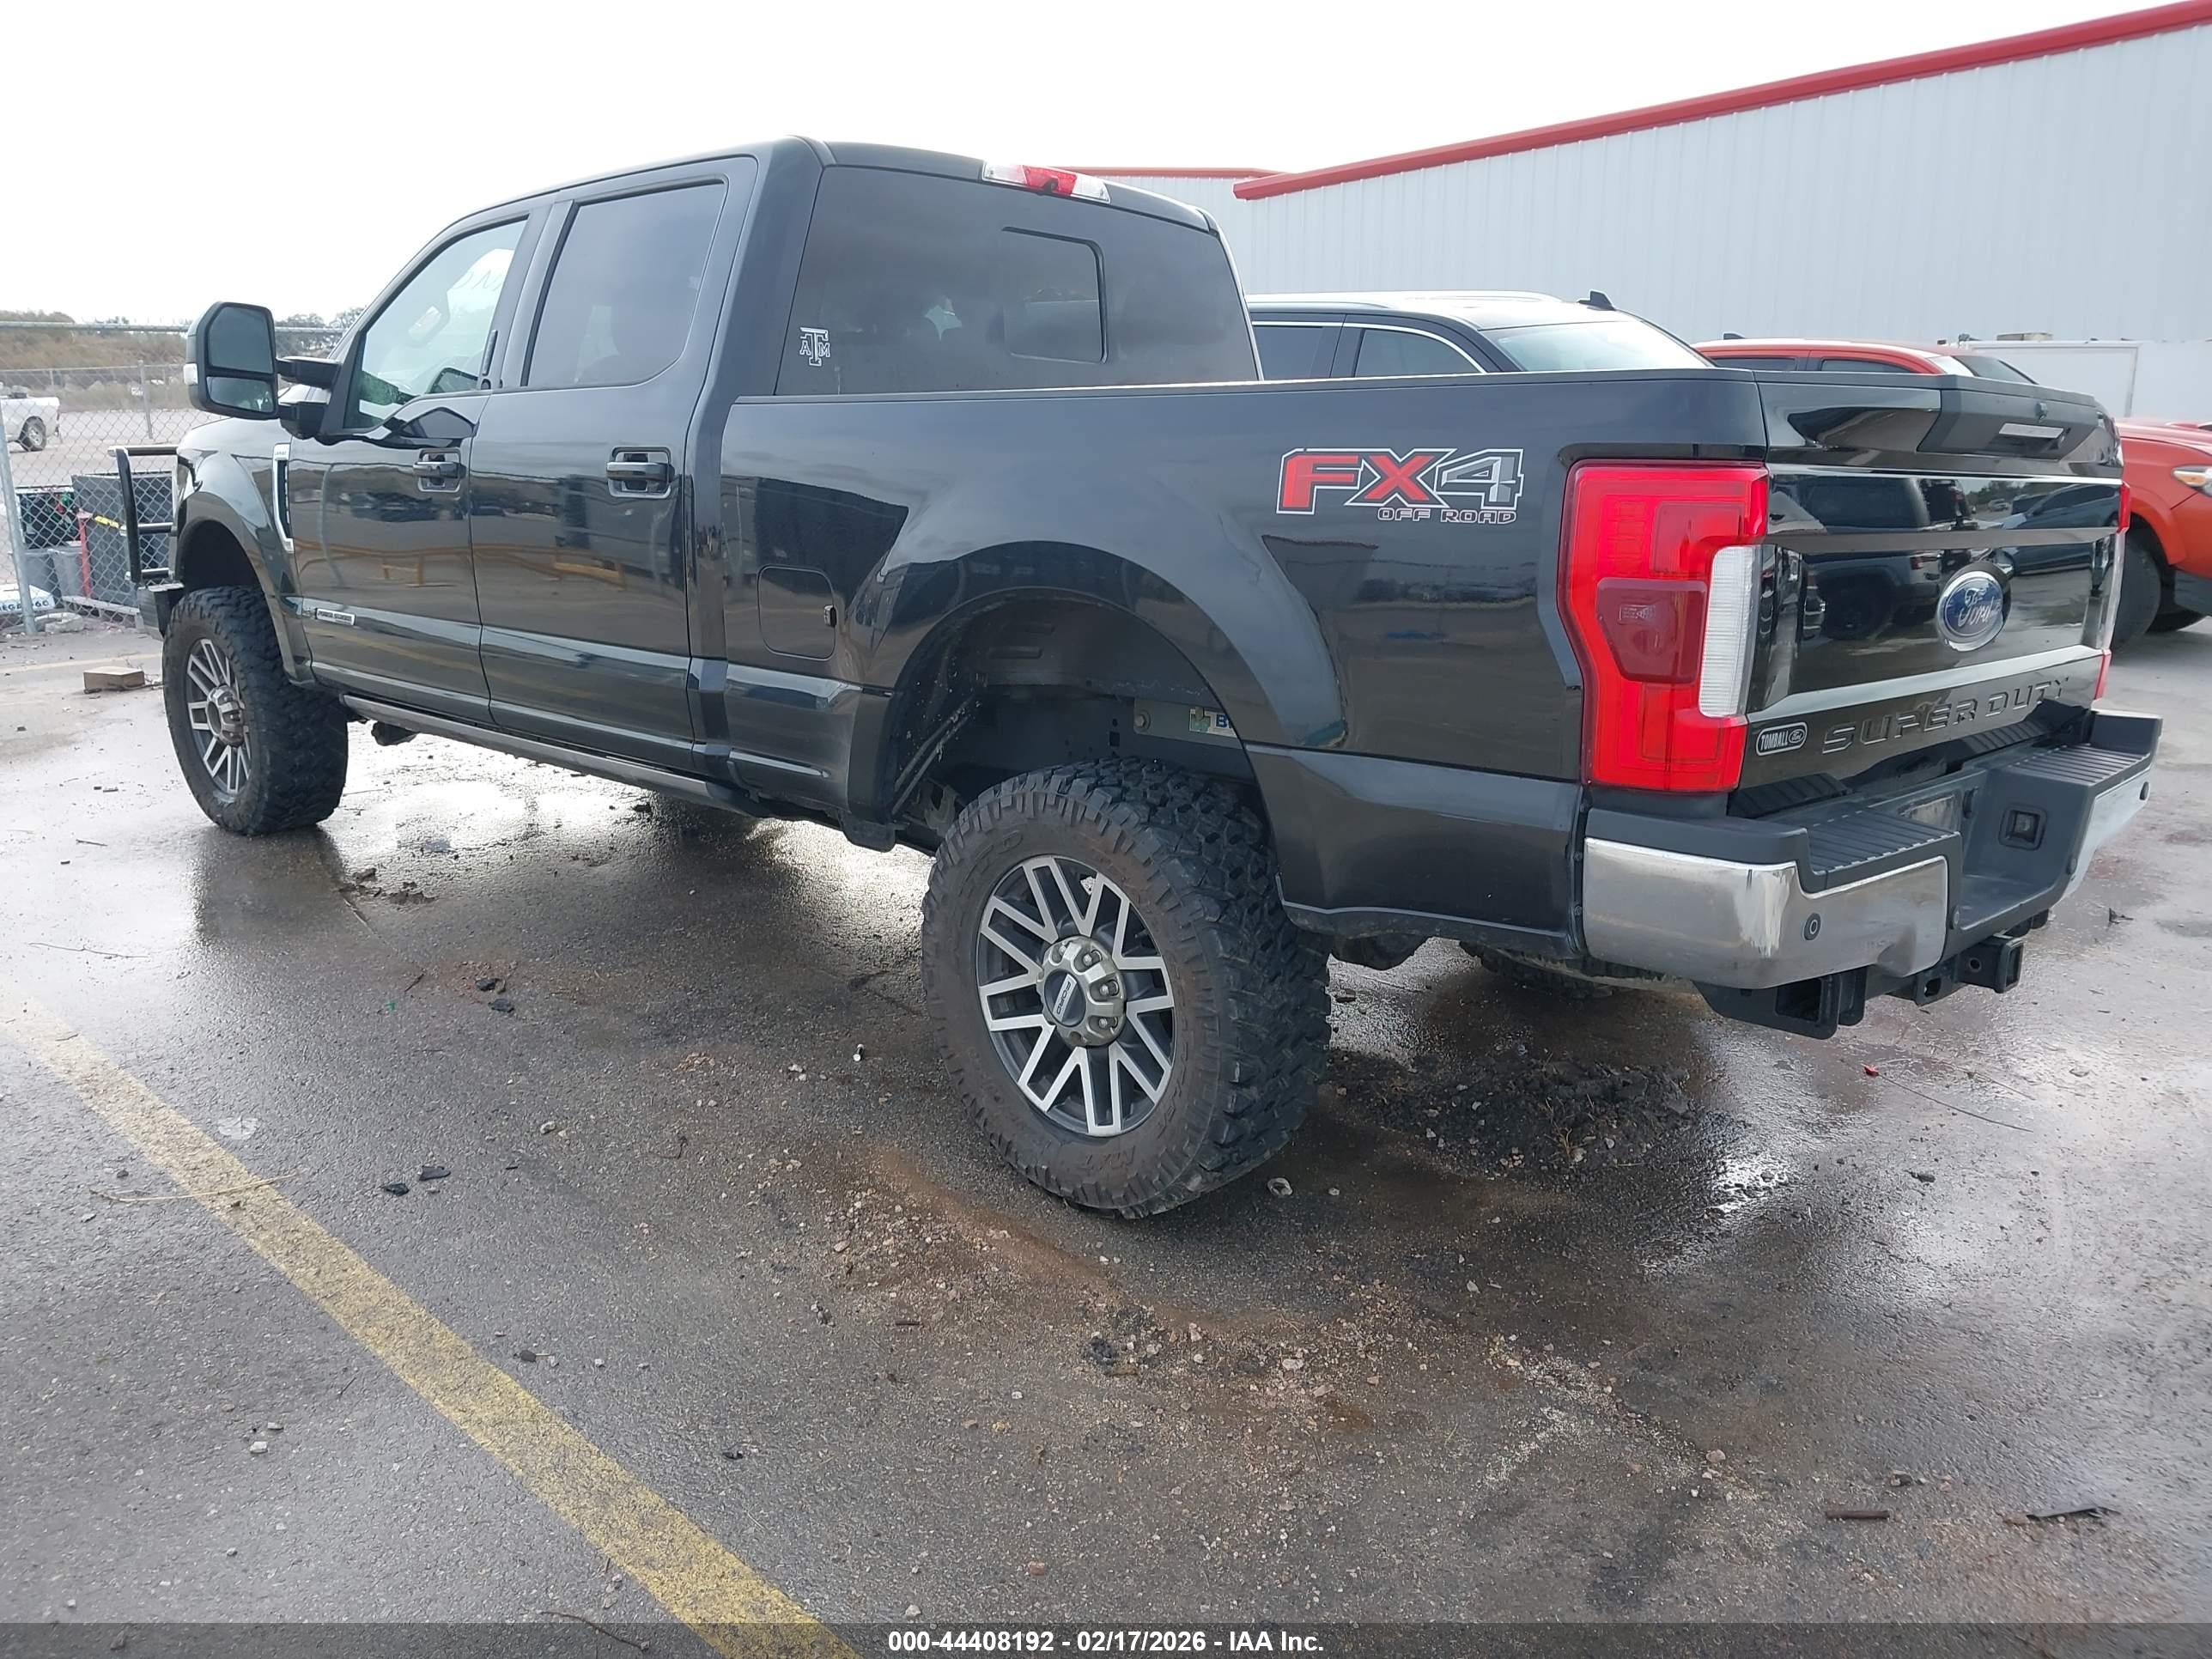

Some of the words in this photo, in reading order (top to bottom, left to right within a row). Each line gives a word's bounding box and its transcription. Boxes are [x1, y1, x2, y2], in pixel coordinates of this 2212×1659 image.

[1276, 447, 1525, 515] FX4
[1377, 507, 1431, 522] OFF
[1440, 508, 1517, 525] ROAD
[1958, 587, 1996, 627] Ford
[1822, 698, 1978, 754] SUPER
[1985, 676, 2069, 717] DUTY
[1759, 730, 1789, 751] TOMBALL
[1056, 981, 1072, 1015] FORD
